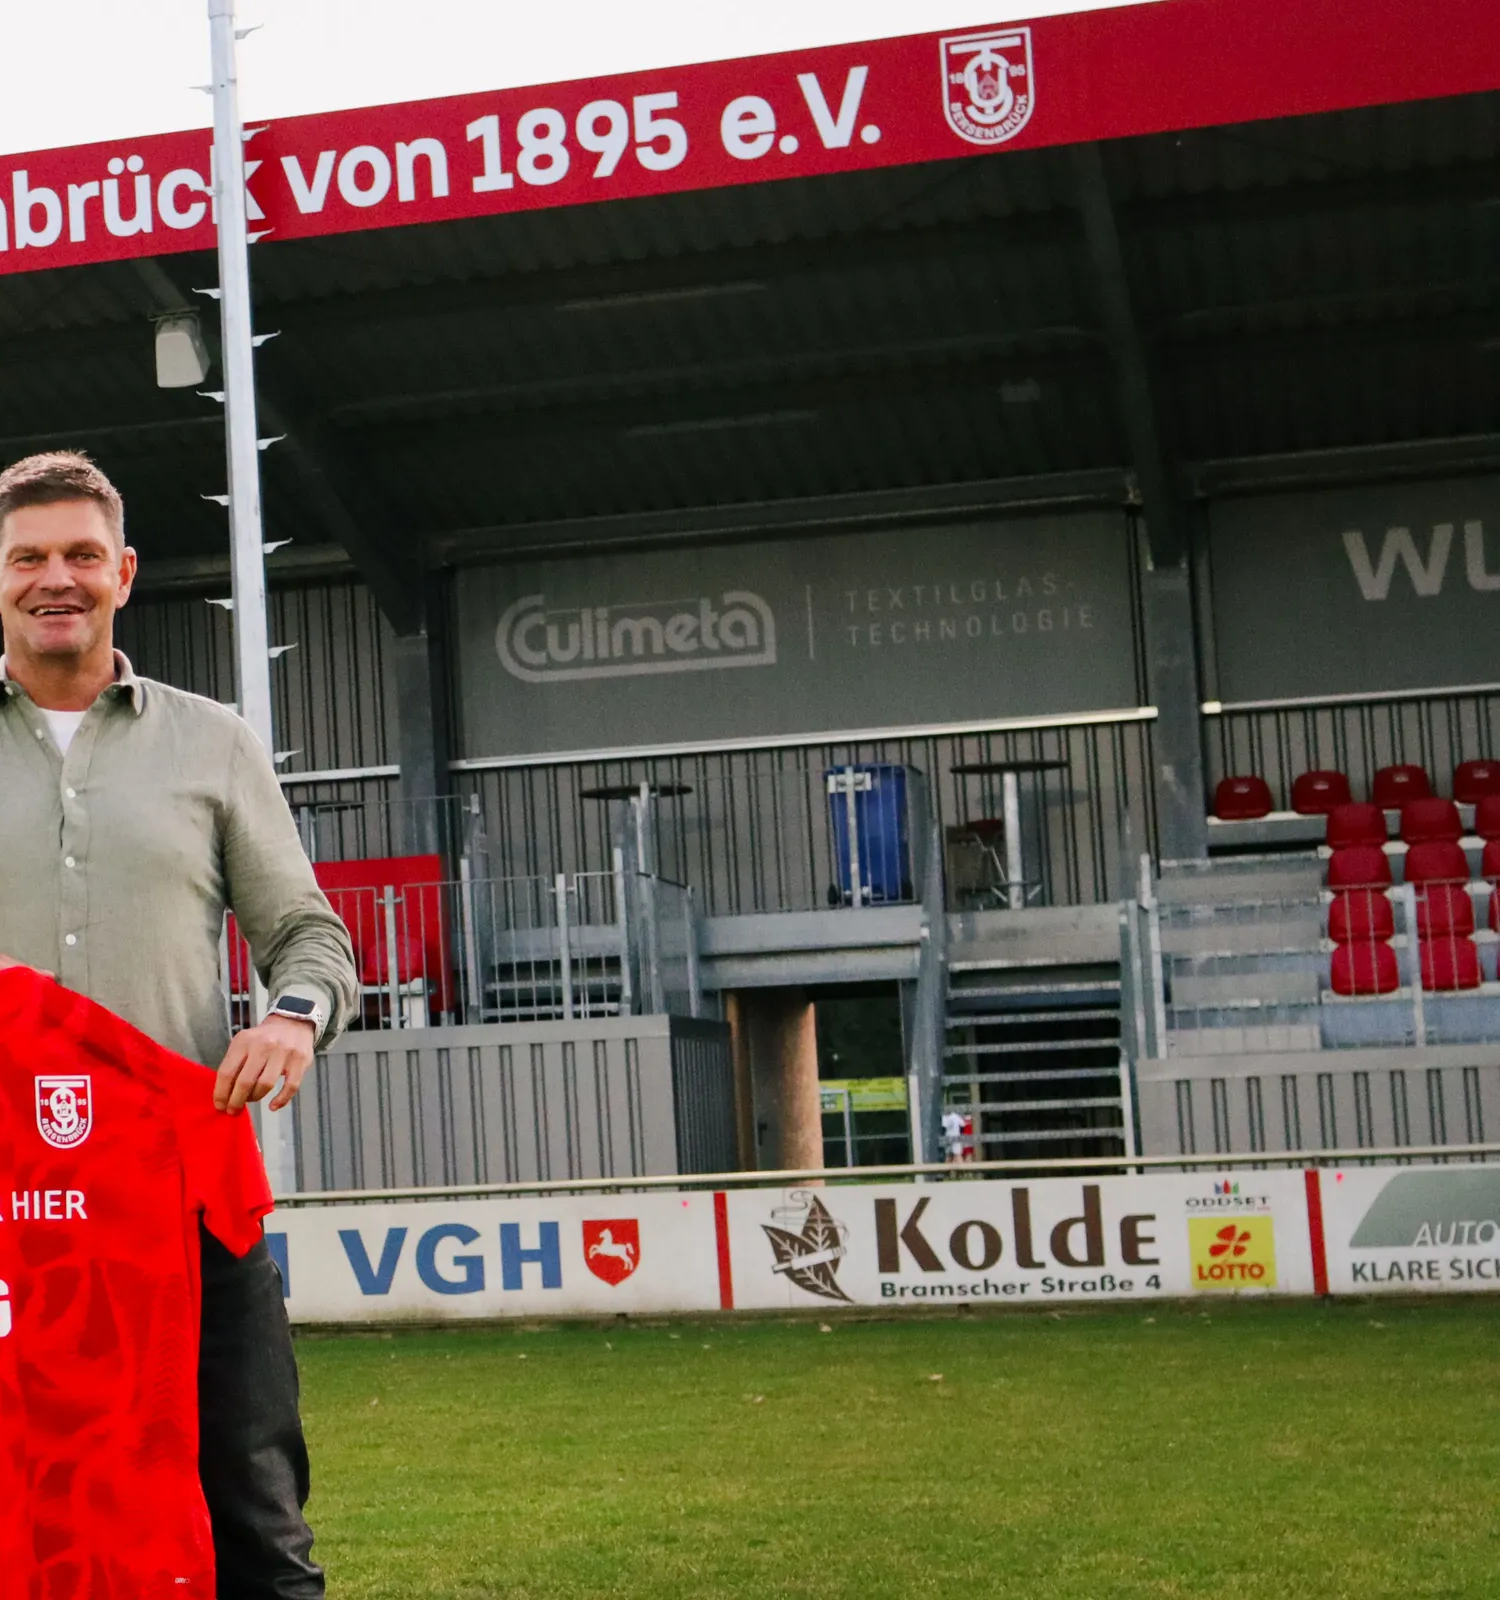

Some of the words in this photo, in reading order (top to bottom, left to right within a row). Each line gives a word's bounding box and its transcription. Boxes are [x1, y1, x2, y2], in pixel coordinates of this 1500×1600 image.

[280, 136, 450, 214] von
[465, 91, 688, 193] 1895
[719, 65, 882, 161] e.V.
[512, 597, 760, 666] Culimeta
[849, 606, 1093, 647] TECHNOLOGIE
[11, 1190, 88, 1221] HIER
[1185, 1196, 1270, 1207] ODDSET
[338, 1220, 563, 1296] VGH
[1197, 1263, 1265, 1281] LOTTO
[1352, 1260, 1441, 1282] KLARE
[1449, 1258, 1500, 1280] SIC
[880, 1279, 1031, 1298] Bramscher
[1041, 1274, 1134, 1294] Straße
[1145, 1274, 1162, 1290] 4
